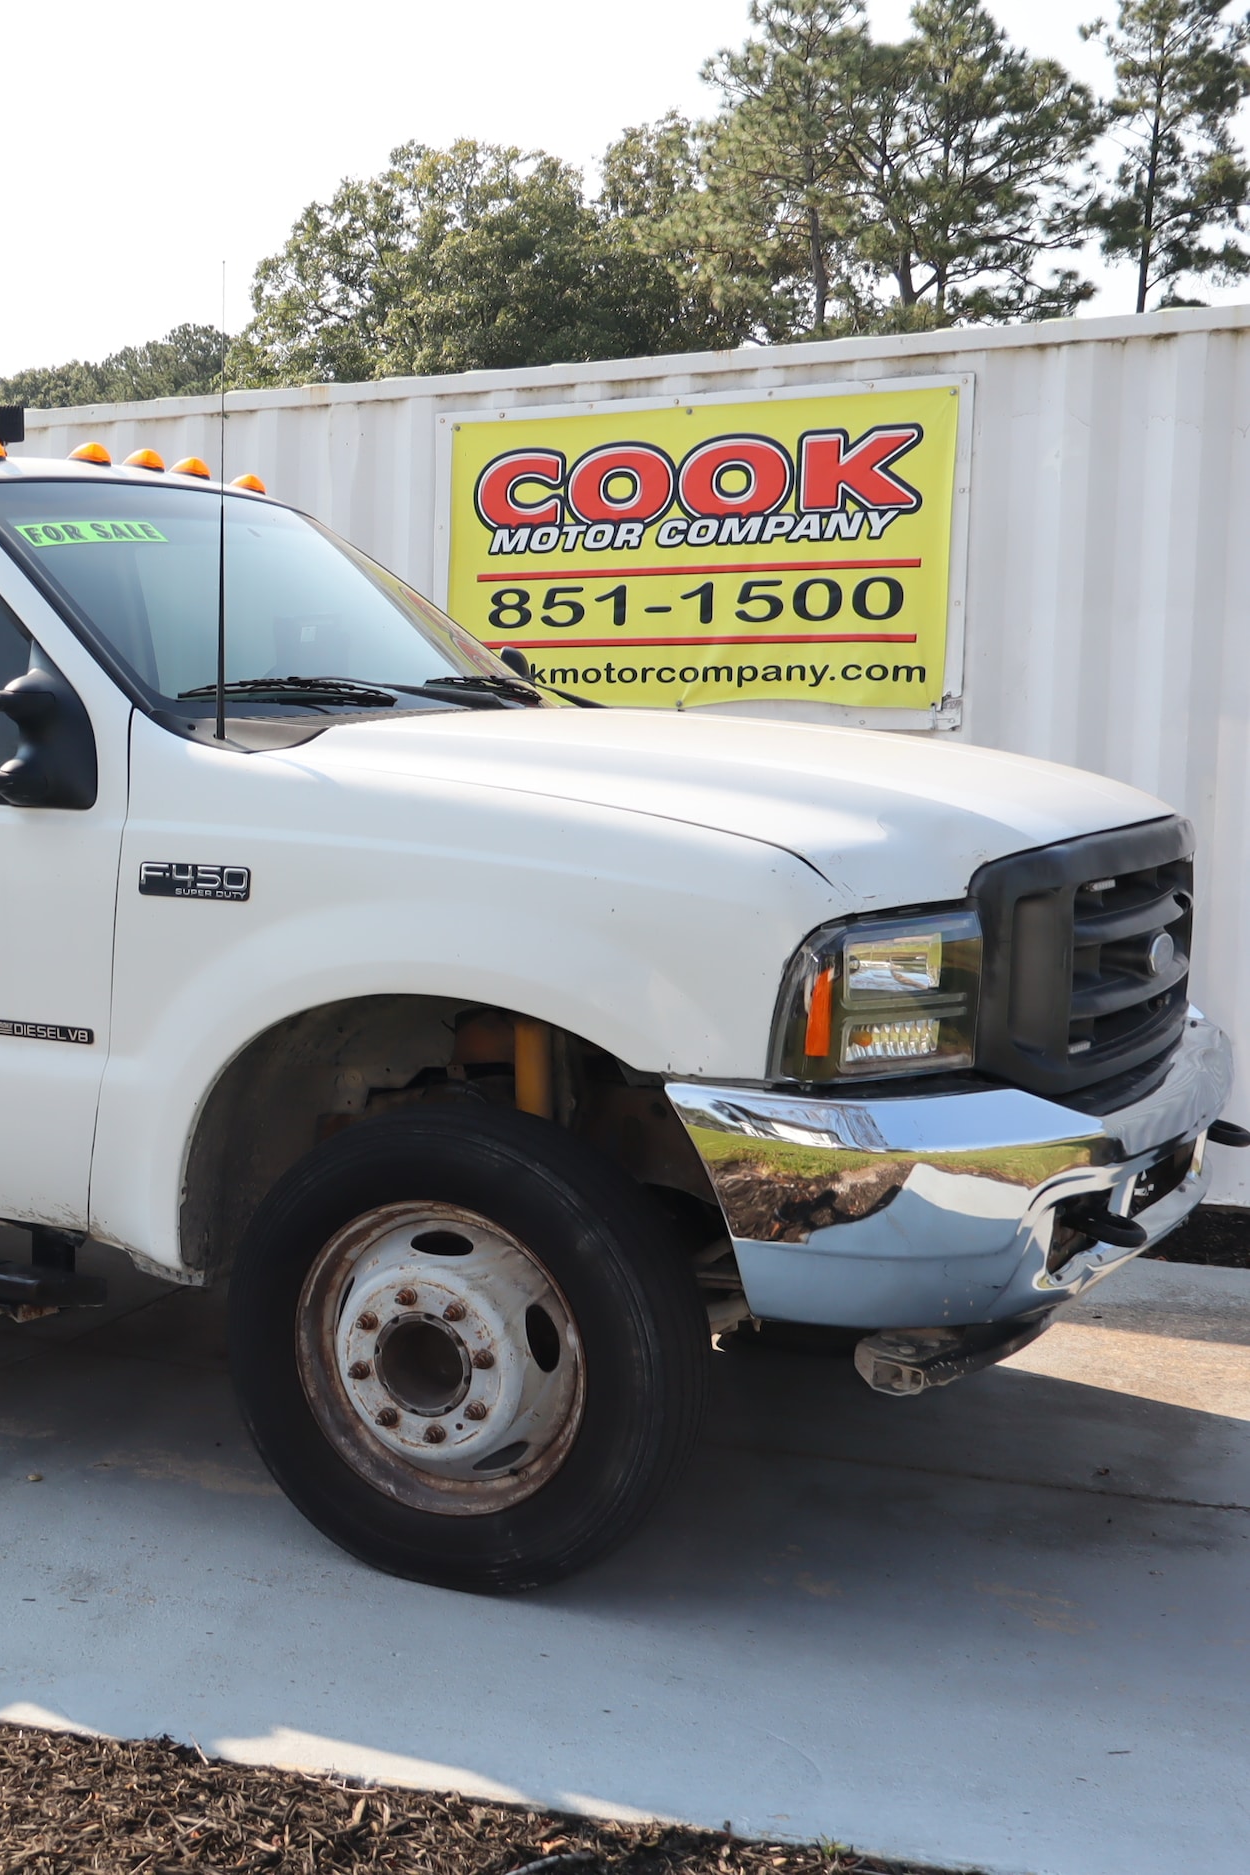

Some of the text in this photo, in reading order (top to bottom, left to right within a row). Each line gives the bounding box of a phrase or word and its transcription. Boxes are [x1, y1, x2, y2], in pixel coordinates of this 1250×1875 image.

[474, 423, 923, 534] COOK
[23, 522, 161, 544] FOR SALE
[489, 509, 901, 555] MOTOR COMPANY
[488, 576, 904, 629] 851-1500
[530, 662, 926, 688] kmotorcompany.com
[175, 888, 246, 899] SUPER DUTY
[13, 1023, 89, 1042] DIESEL V8
